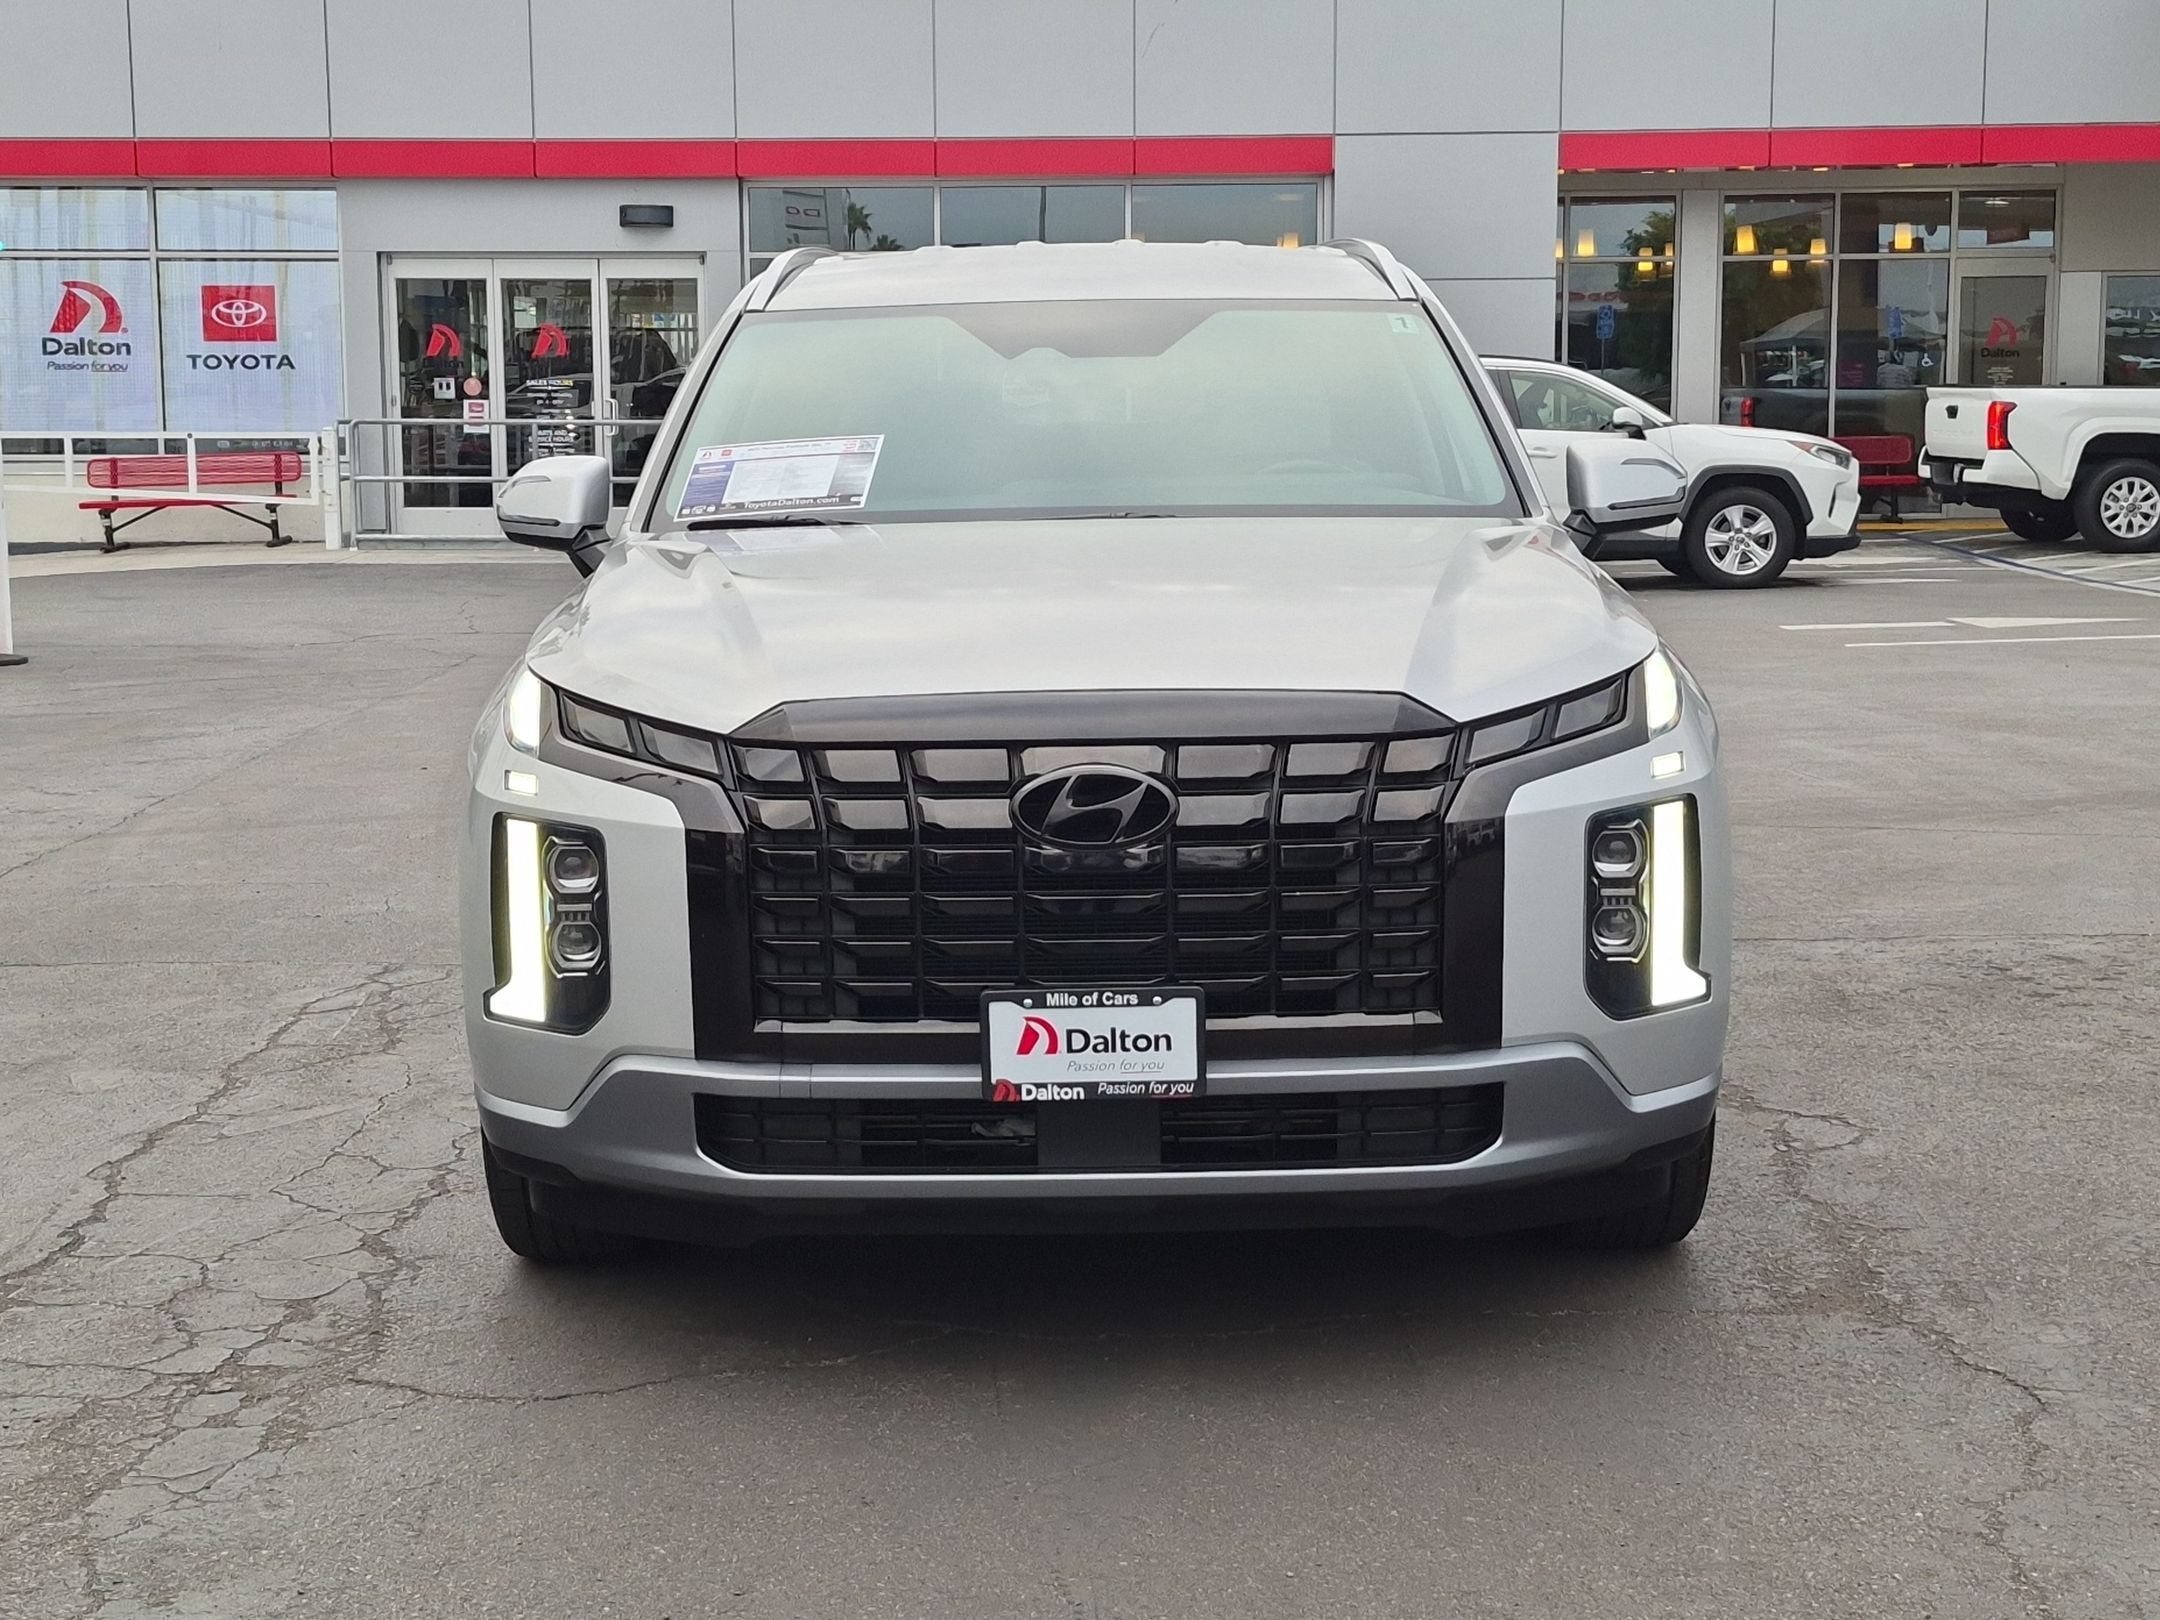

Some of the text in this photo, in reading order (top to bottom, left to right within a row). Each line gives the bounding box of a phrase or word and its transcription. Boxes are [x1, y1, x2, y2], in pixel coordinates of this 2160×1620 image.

[41, 337, 132, 356] Dalton
[1980, 347, 2020, 359] Dalton
[47, 360, 129, 373] Passion for you
[187, 354, 296, 371] TOYOTA
[743, 496, 840, 510] ToyotaDalton.com
[1046, 992, 1138, 1007] Mile of Cars
[1066, 1027, 1172, 1054] Dalton
[1066, 1059, 1165, 1073] Passion for you
[1020, 1081, 1195, 1101] Dalton Passion for you
